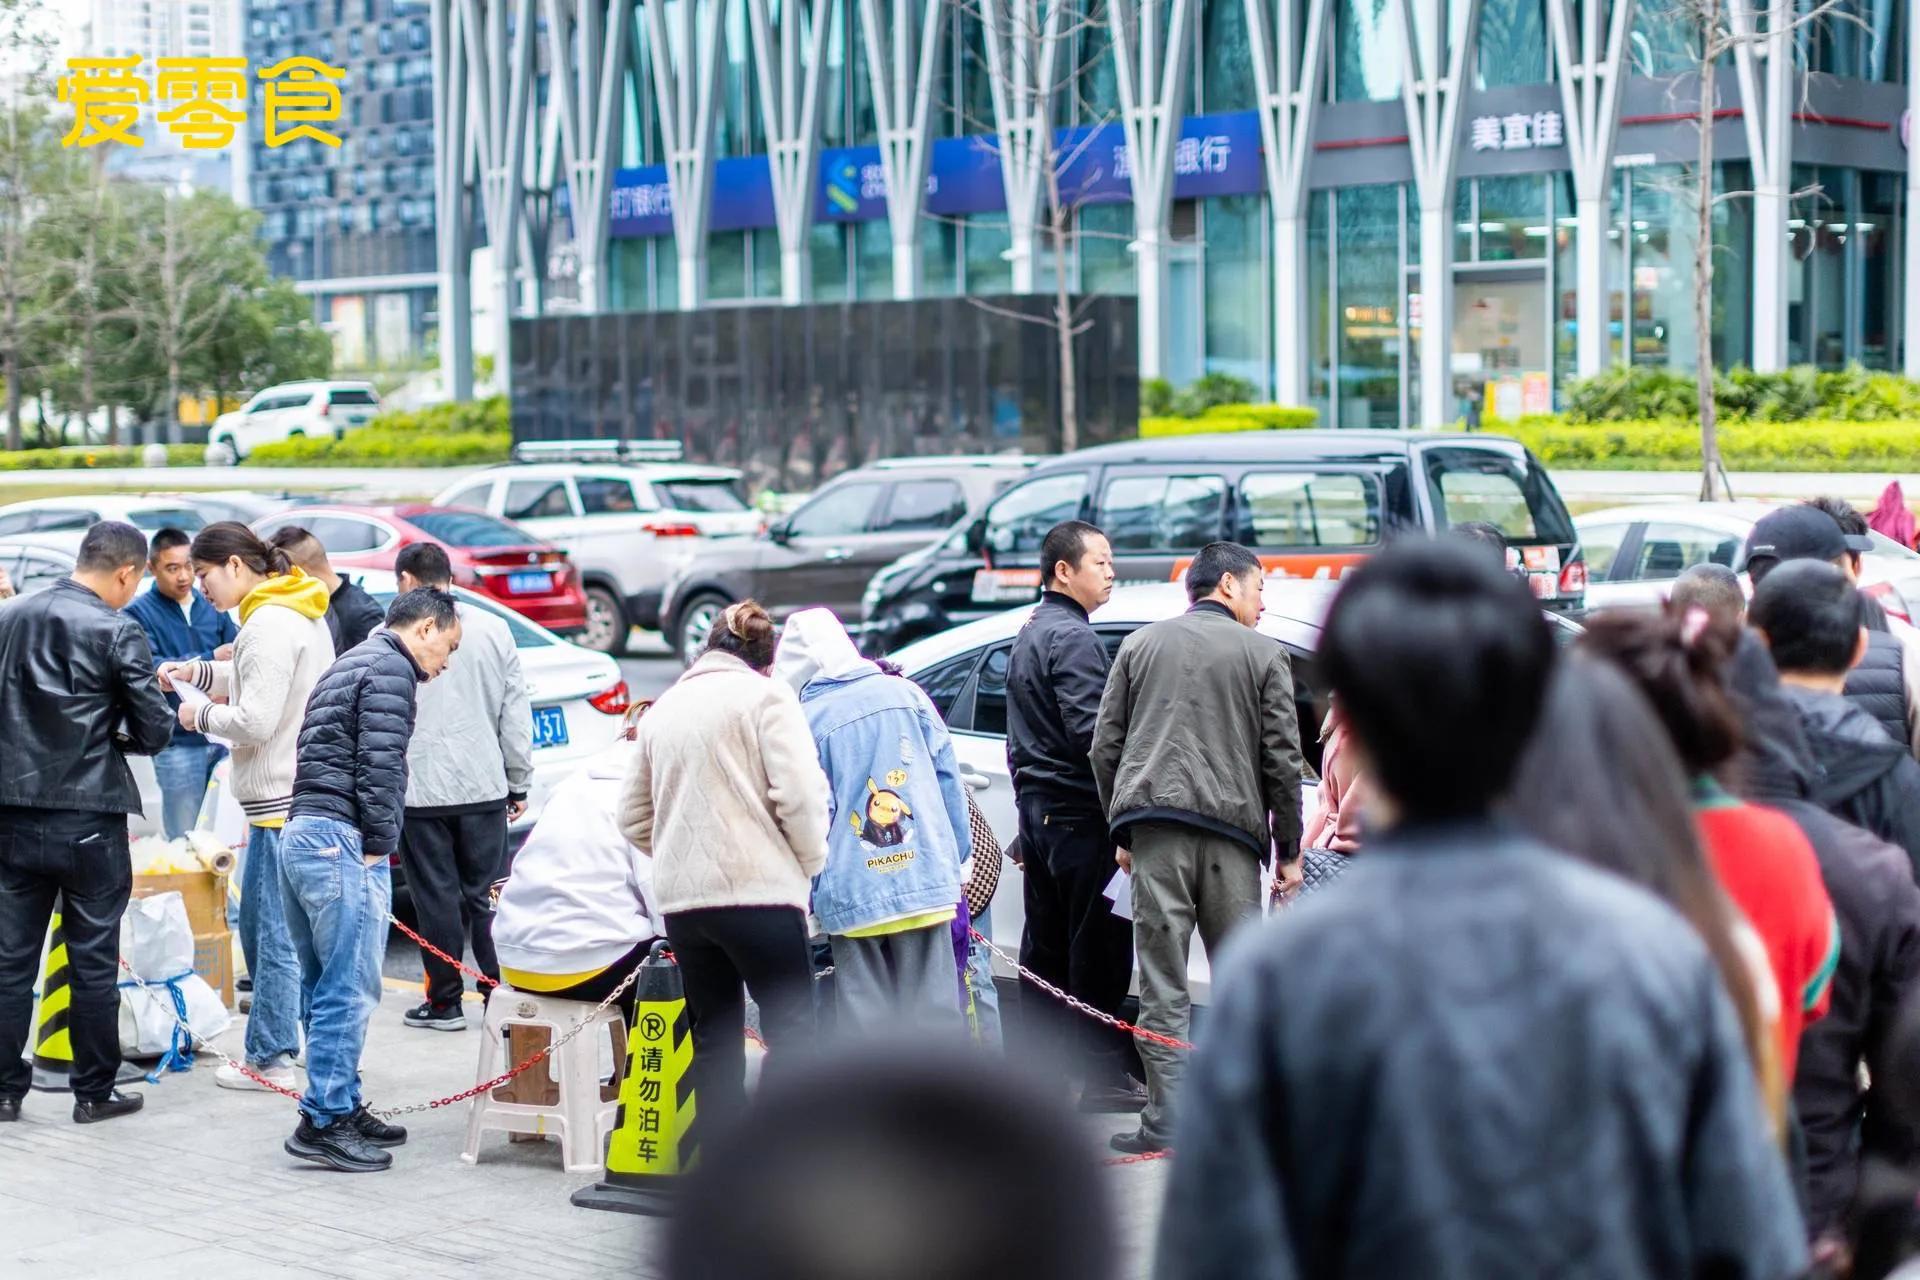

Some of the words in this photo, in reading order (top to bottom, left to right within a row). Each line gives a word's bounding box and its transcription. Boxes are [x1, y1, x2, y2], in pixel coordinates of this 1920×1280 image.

[1471, 111, 1562, 152] 美宜佳
[867, 850, 914, 868] PIKACHU
[637, 1046, 663, 1163] 请勿泊车
